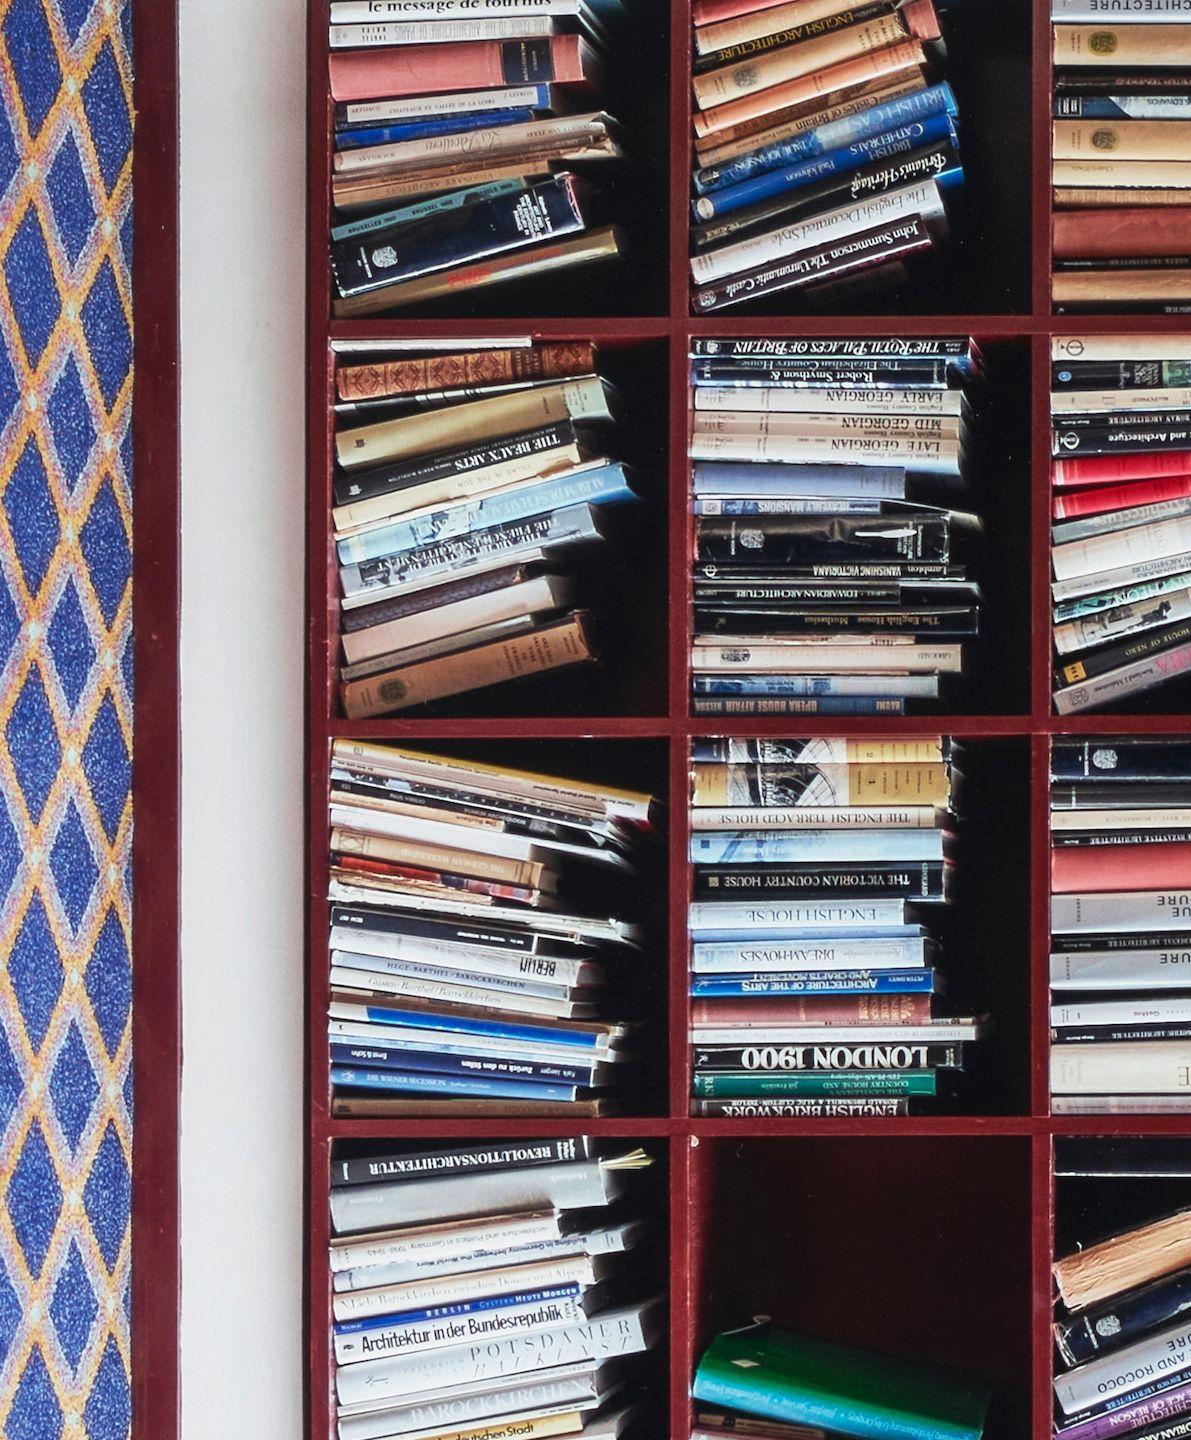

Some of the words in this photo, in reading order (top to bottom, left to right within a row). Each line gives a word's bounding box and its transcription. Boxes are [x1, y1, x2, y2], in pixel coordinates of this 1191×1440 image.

[369, 0, 381, 12] le
[387, 1, 452, 13] message
[806, 12, 853, 33] ENGLISH
[717, 28, 802, 60] ARCHITECTURE
[906, 189, 929, 202] The
[863, 198, 903, 216] English
[802, 209, 859, 234] Decorated
[771, 227, 798, 244] Style
[893, 222, 919, 238] John
[831, 231, 892, 258] Summerson
[812, 253, 828, 268] The
[756, 260, 809, 284] Unromantic
[726, 279, 754, 296] Castle
[532, 434, 560, 448] THE
[831, 439, 899, 451] GEORGIAN
[907, 440, 940, 452] LATE
[487, 441, 530, 461] BEAUX
[455, 455, 485, 470] ARTS
[718, 814, 759, 824] HOUSE
[762, 813, 828, 824] TERRACED
[831, 813, 882, 824] ENGLISH
[885, 813, 910, 823] THE
[724, 876, 760, 887] HOUSE
[764, 876, 819, 887] COUNTRY
[823, 875, 884, 886] VICTORIAN
[889, 874, 910, 885] THE
[746, 910, 801, 921] HOUSE
[804, 908, 875, 921] ENGLISH
[520, 958, 556, 977] BERLIN
[742, 1049, 806, 1069] 1900
[812, 1047, 928, 1068] LONDON
[369, 1146, 551, 1175] REVOLUTIONSARCHITEKTUR
[361, 1328, 430, 1352] Architektur
[434, 1324, 444, 1341] in
[446, 1325, 465, 1338] der
[469, 1304, 562, 1334] Bundesrepublik
[1157, 1351, 1185, 1368] AND
[1097, 1365, 1154, 1393] ROCOCO
[505, 1423, 534, 1437] Stadt
